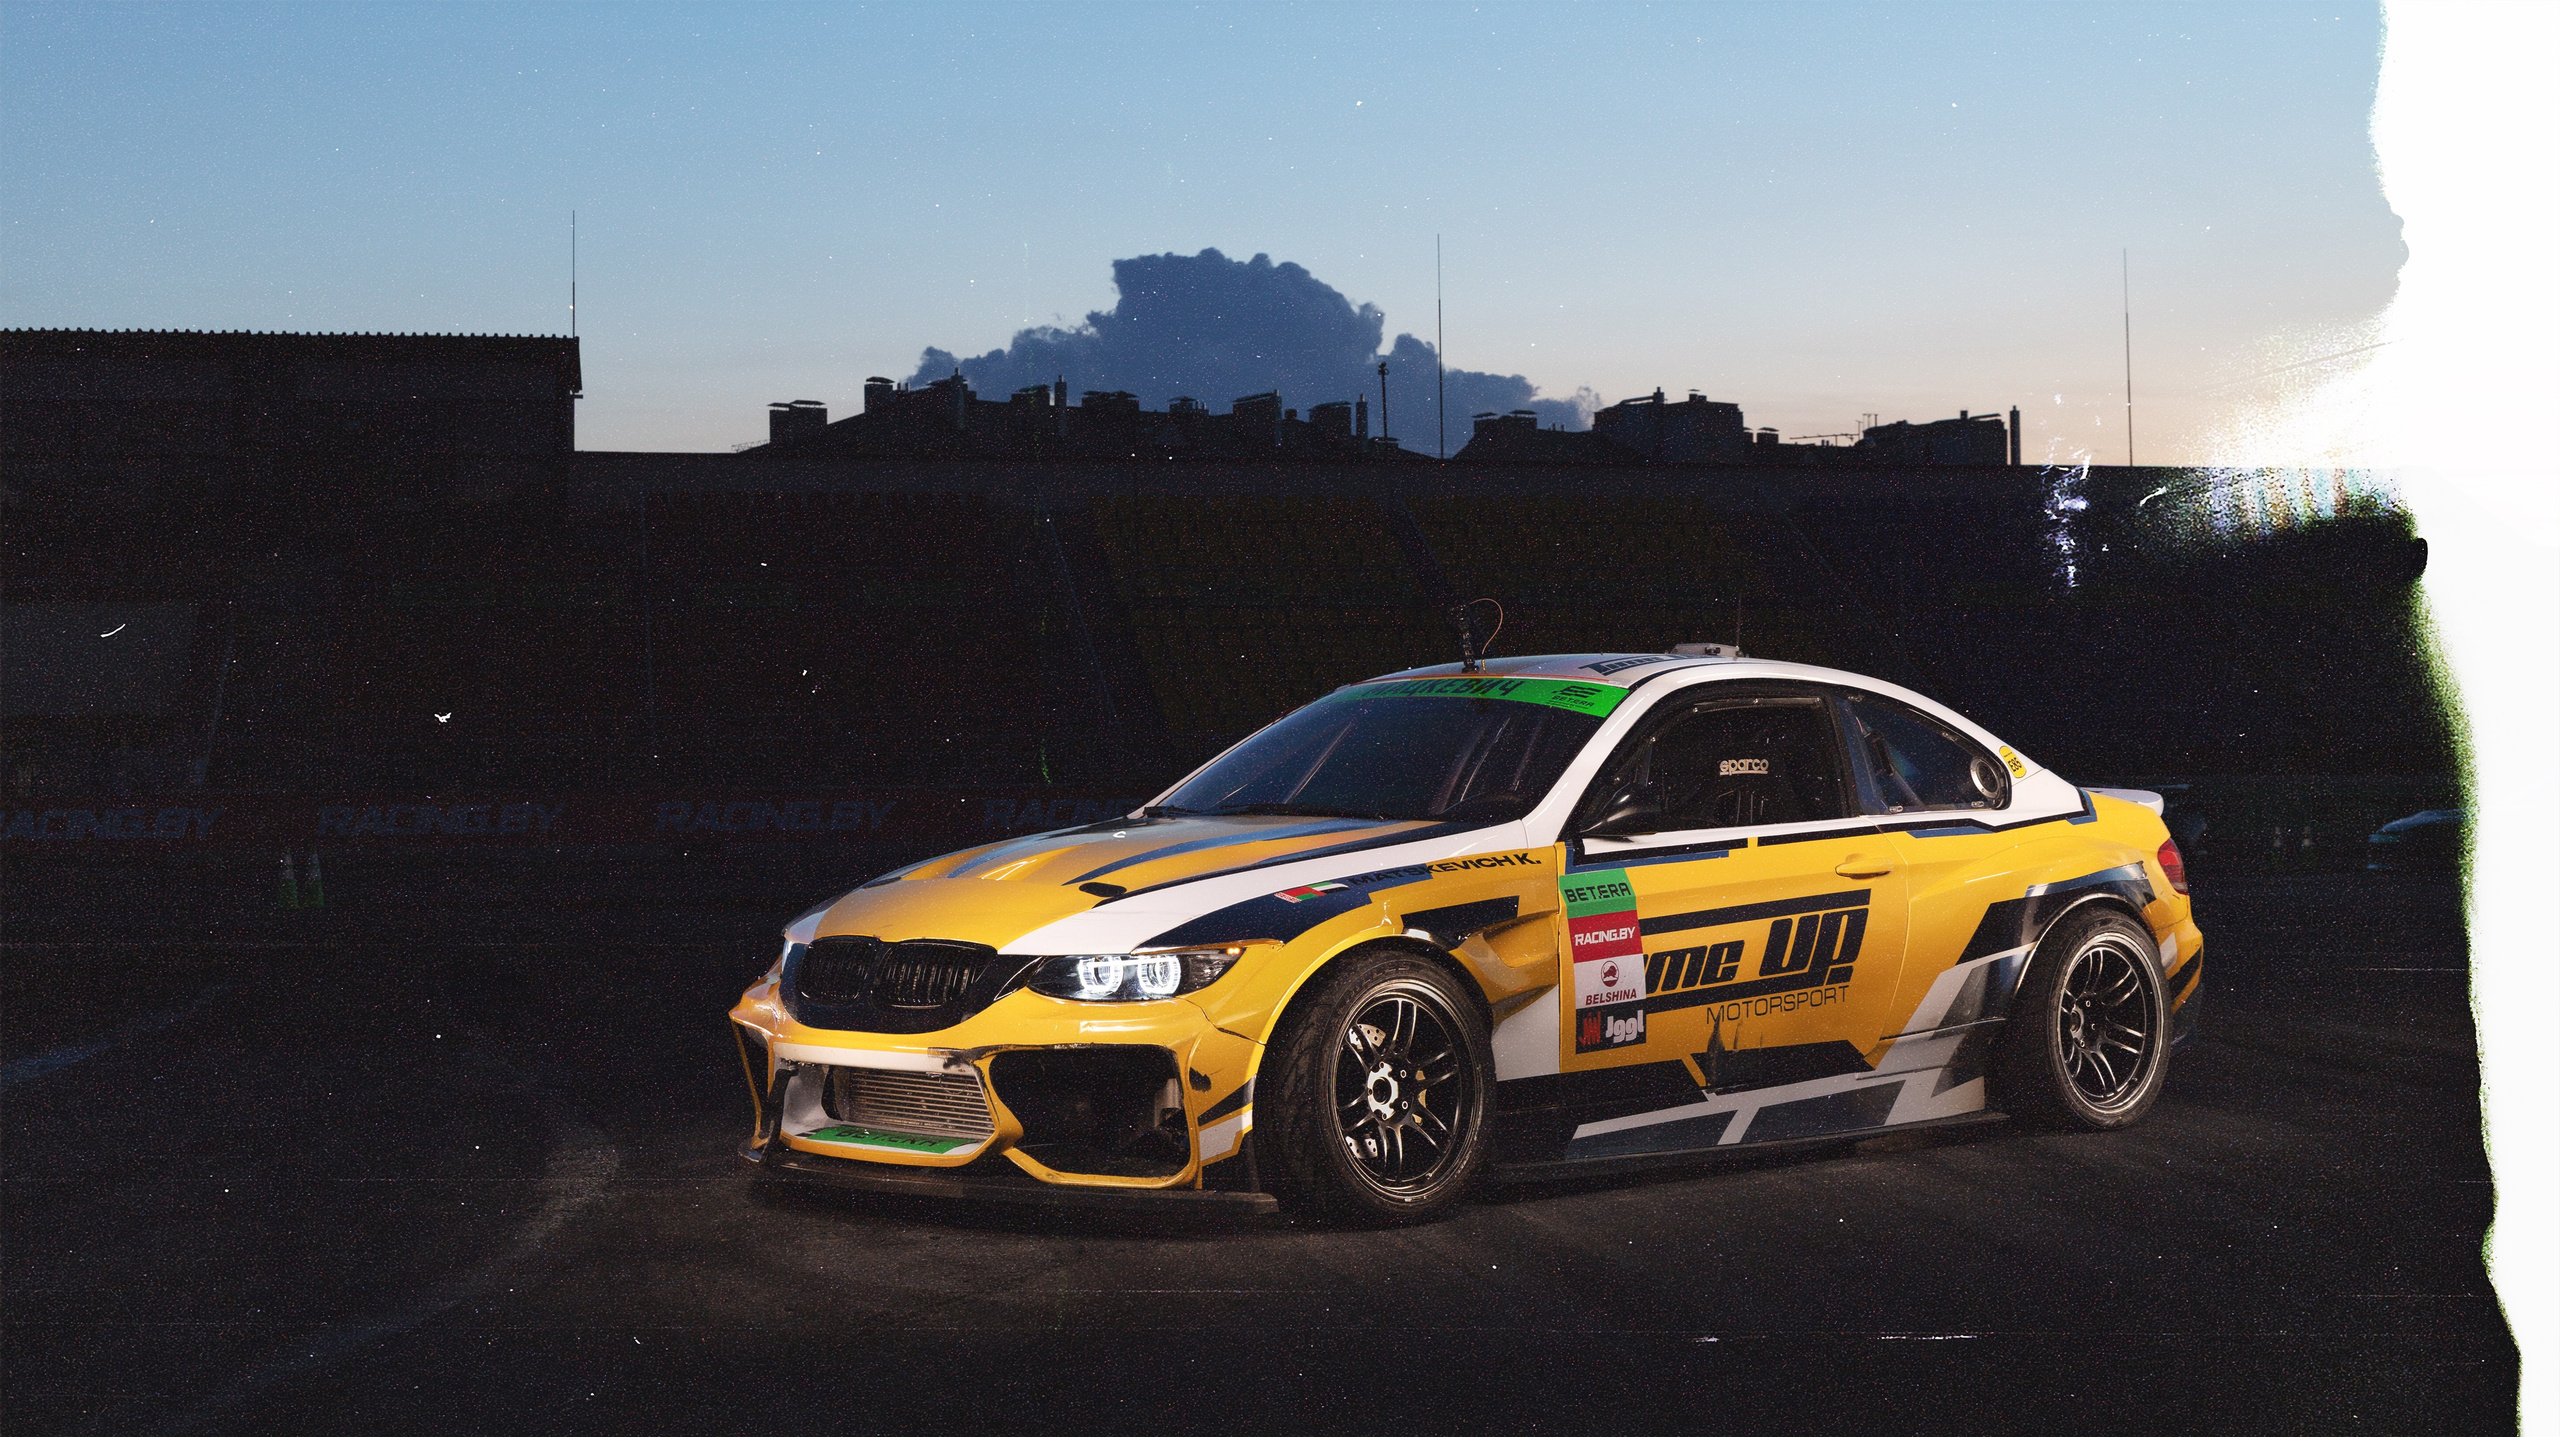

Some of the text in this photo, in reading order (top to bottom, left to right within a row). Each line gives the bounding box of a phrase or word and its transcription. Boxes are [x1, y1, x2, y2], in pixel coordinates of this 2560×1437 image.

[0, 806, 226, 840] ACING.BY
[315, 802, 564, 836] RACING.BY
[655, 800, 897, 832] RACING.BY
[1348, 852, 1542, 887] MATSKEVICH K.
[1564, 882, 1632, 903] BETERA
[1574, 926, 1636, 947] RACING.BY
[1585, 987, 1637, 1006] BELSHINA
[1706, 985, 1850, 1025] MOTORSPORT
